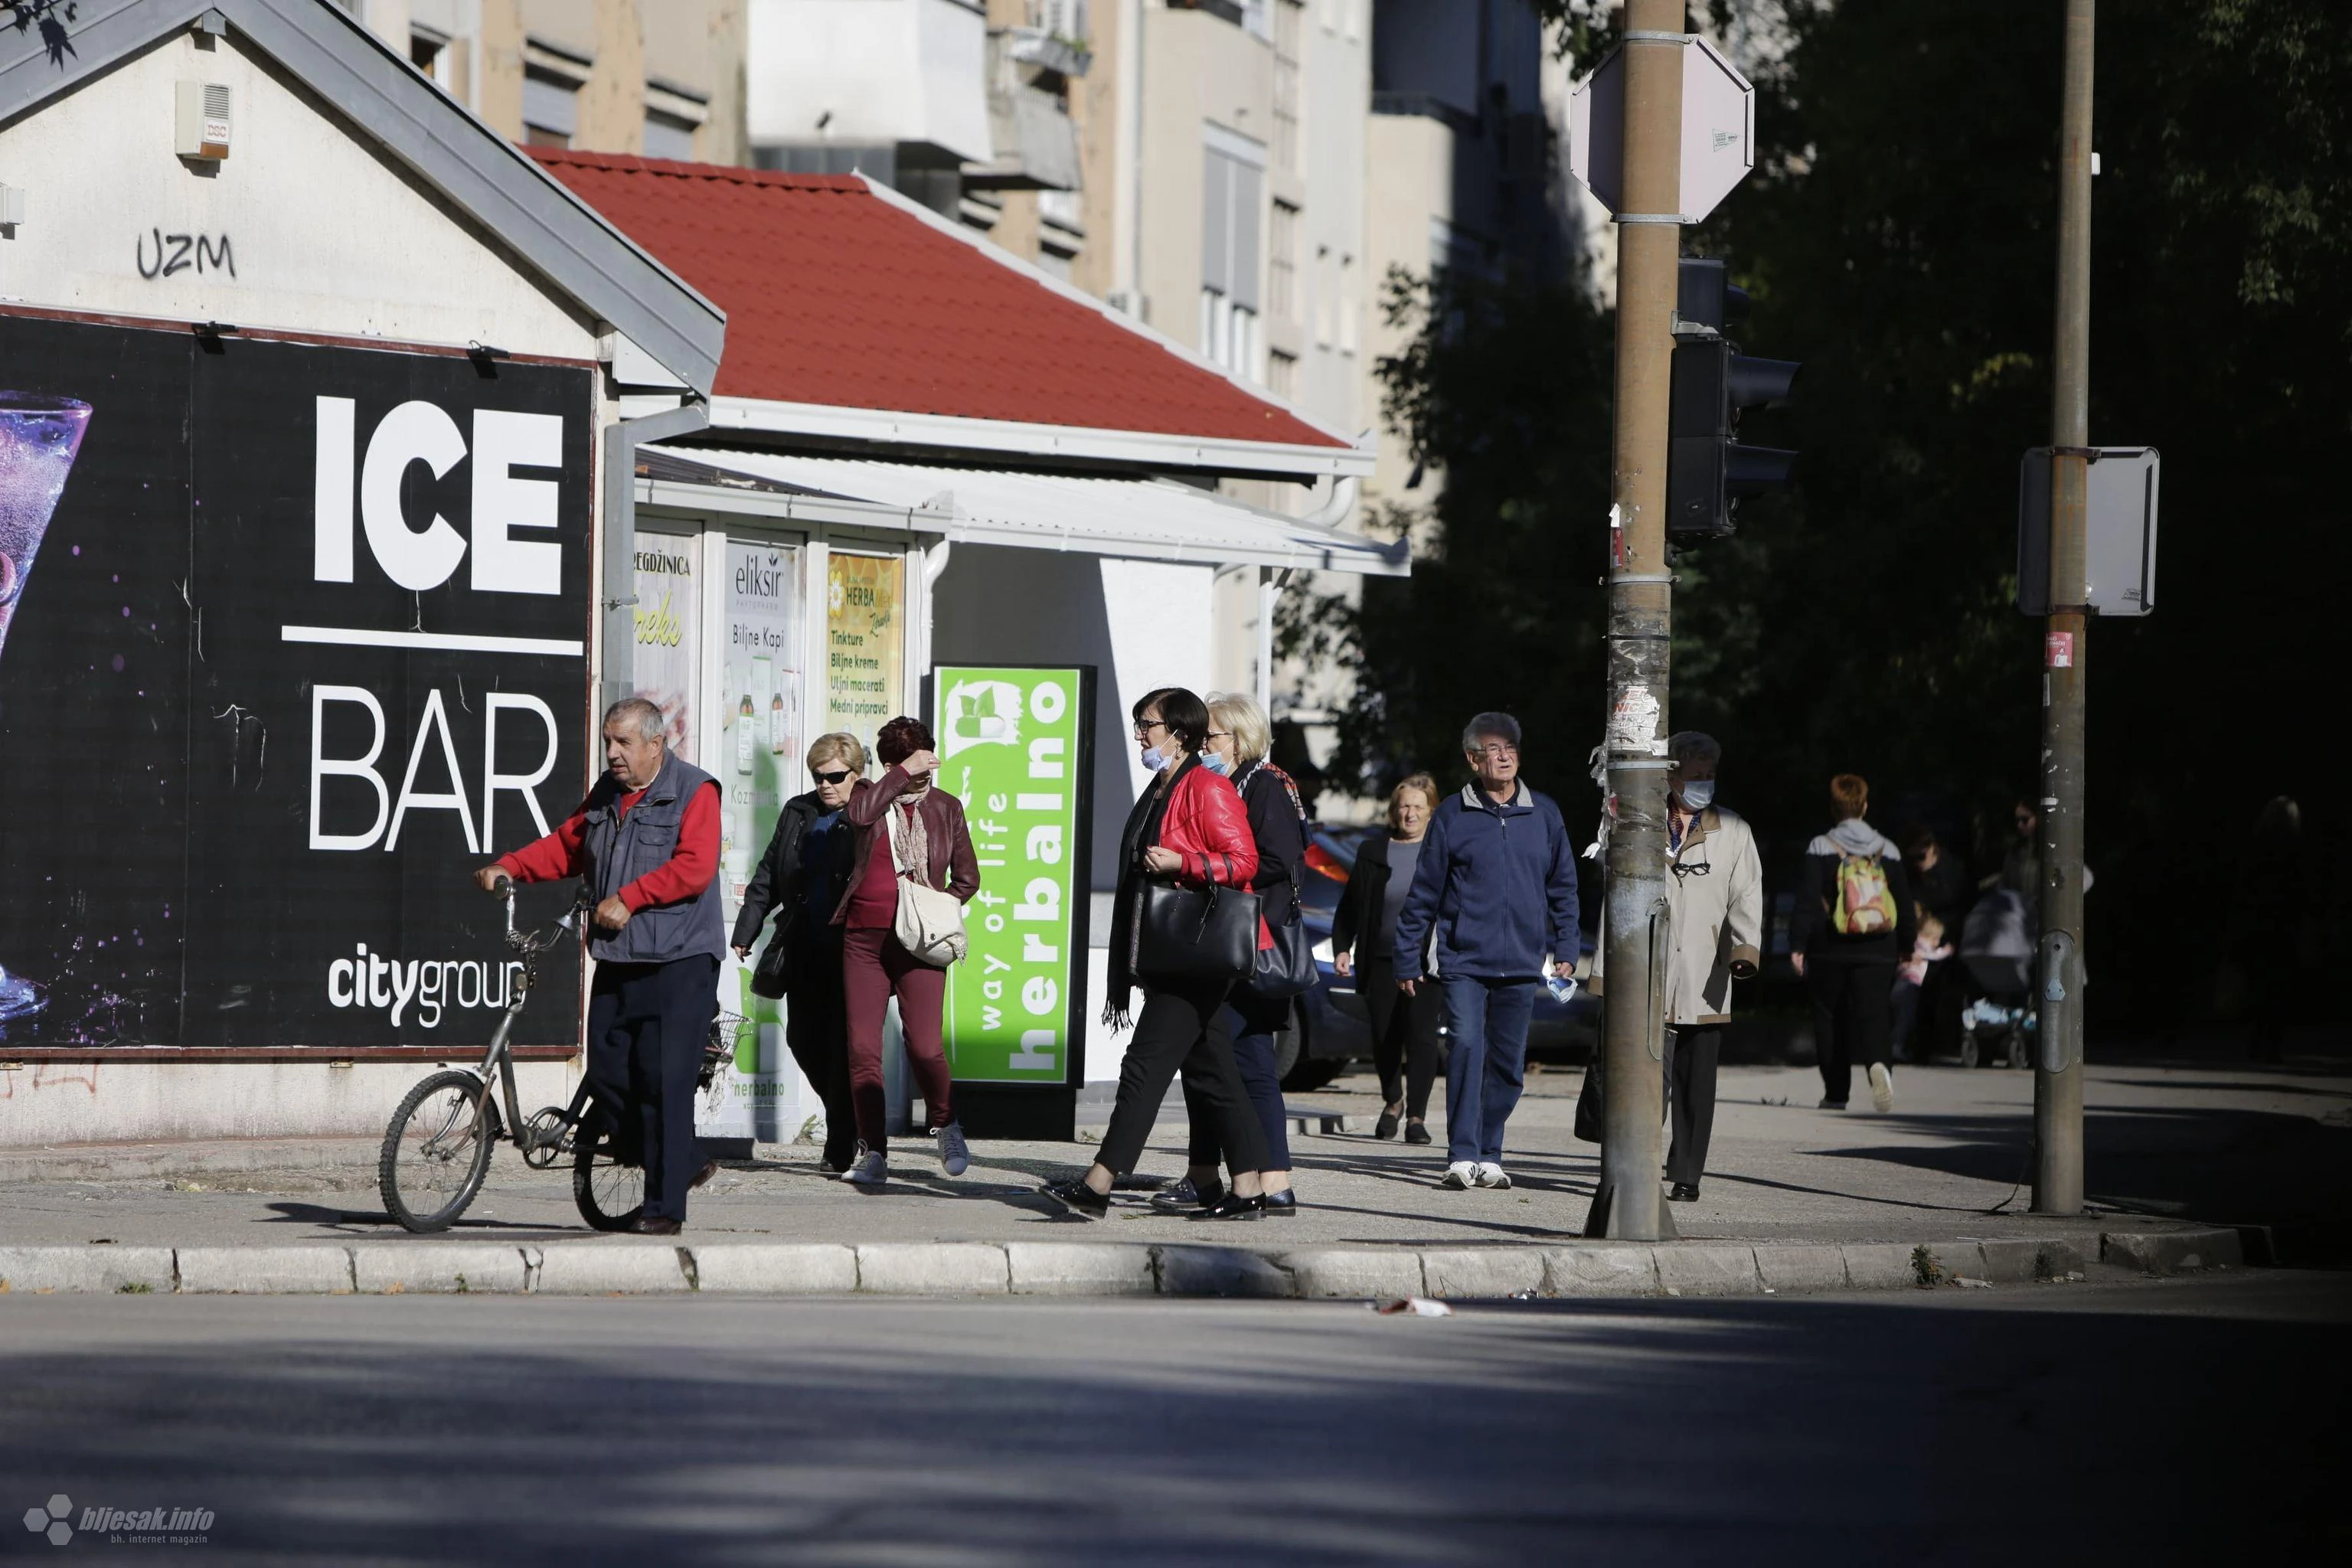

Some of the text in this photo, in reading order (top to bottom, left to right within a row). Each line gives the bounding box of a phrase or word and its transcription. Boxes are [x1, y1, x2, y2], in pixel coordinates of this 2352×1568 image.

[207, 124, 227, 138] DSC
[137, 226, 236, 279] UZM
[315, 395, 564, 595] ICE
[736, 554, 781, 597] eliksir
[733, 622, 784, 652] Biljne Kapi
[831, 629, 864, 646] Tinkture
[831, 652, 878, 671] Biljne kreme
[830, 675, 884, 694] Uljni macerati
[830, 698, 888, 718] Medni pripravci
[309, 684, 558, 854] BAR
[730, 784, 779, 806] Kozmetika
[1009, 681, 1067, 1070] herbalno
[977, 792, 1011, 1031] way of life
